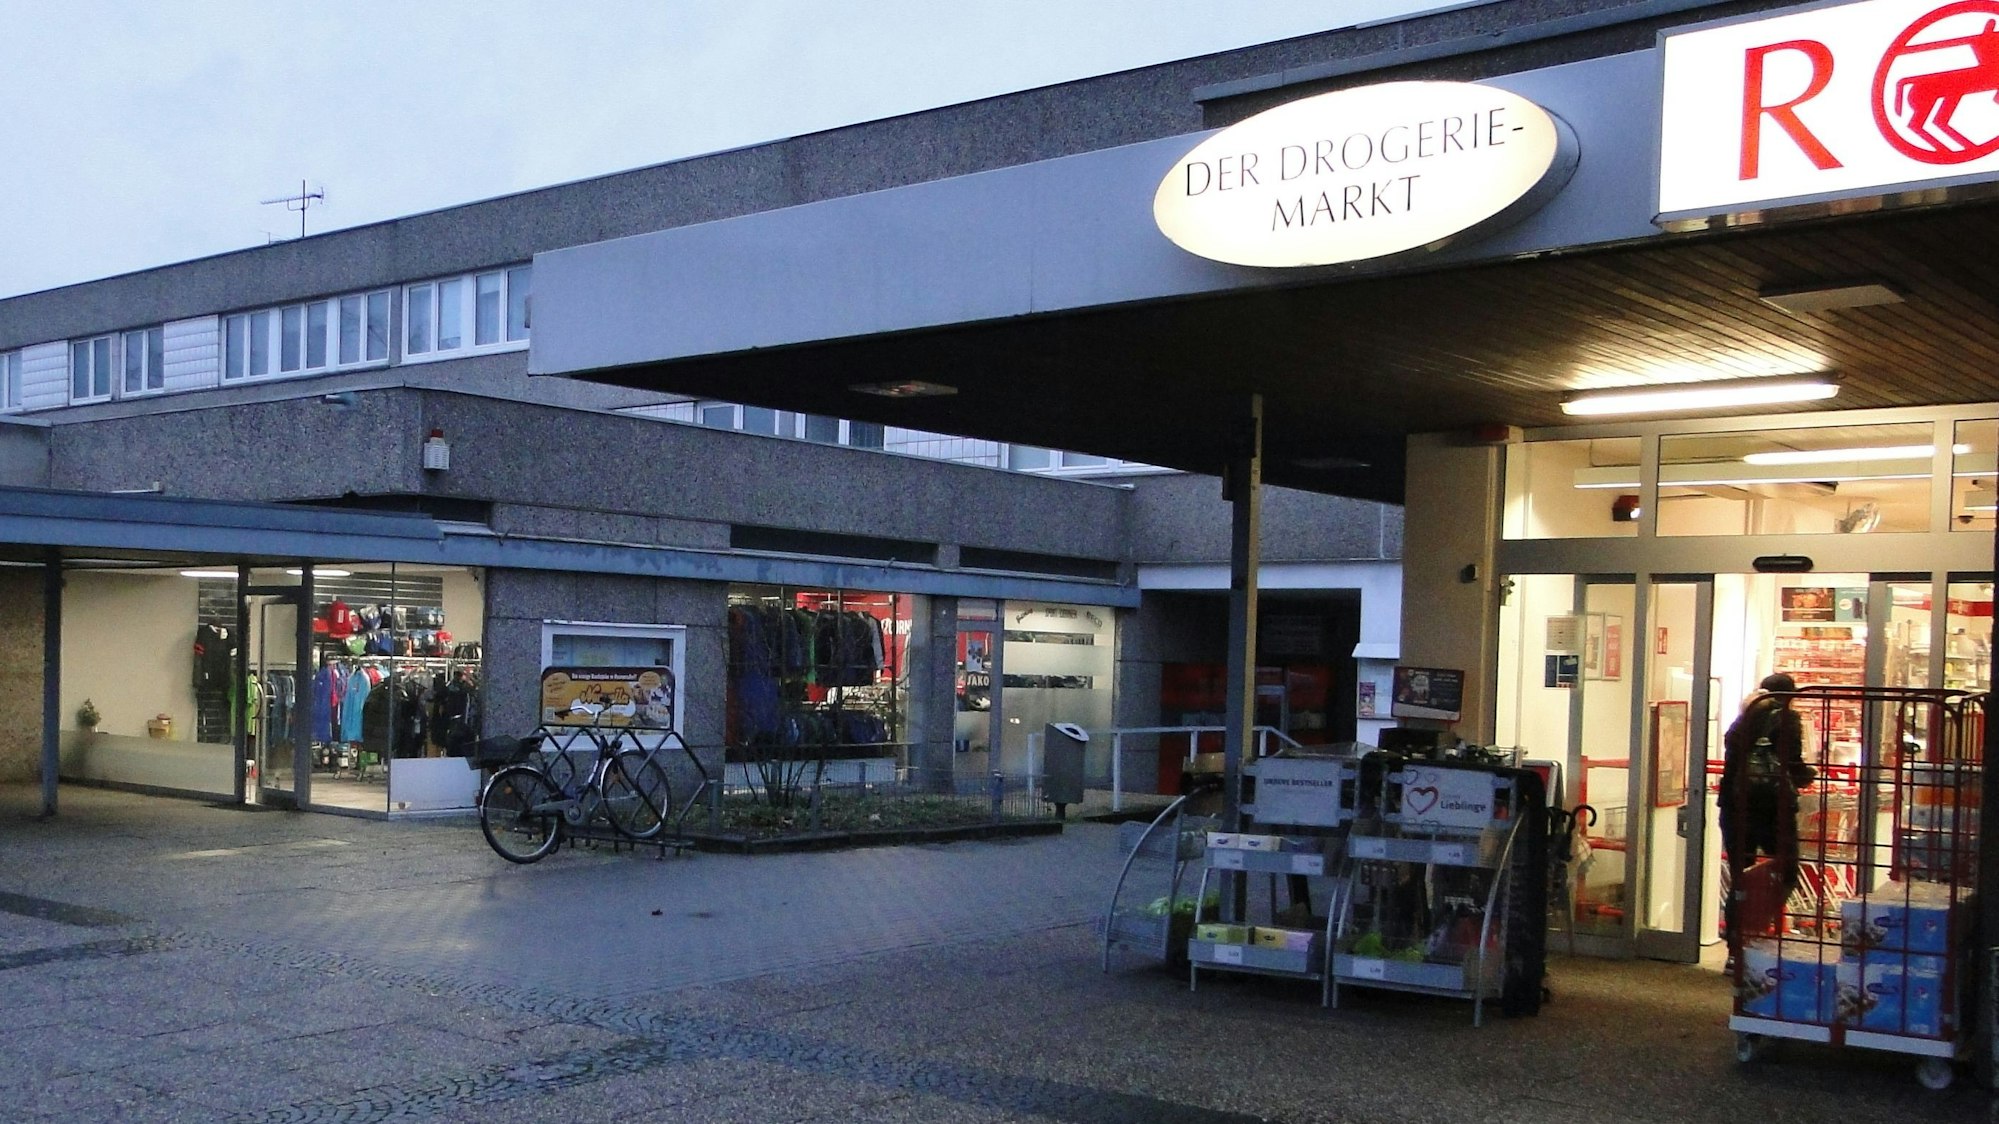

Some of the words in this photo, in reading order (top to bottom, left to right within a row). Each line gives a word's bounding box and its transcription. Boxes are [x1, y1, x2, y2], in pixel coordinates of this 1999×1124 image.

[1185, 152, 1261, 197] DER
[1280, 106, 1525, 182] DROGERIE-
[1271, 174, 1422, 233] MARKT
[966, 674, 990, 687] JAKO
[1440, 801, 1488, 813] Lieblinge
